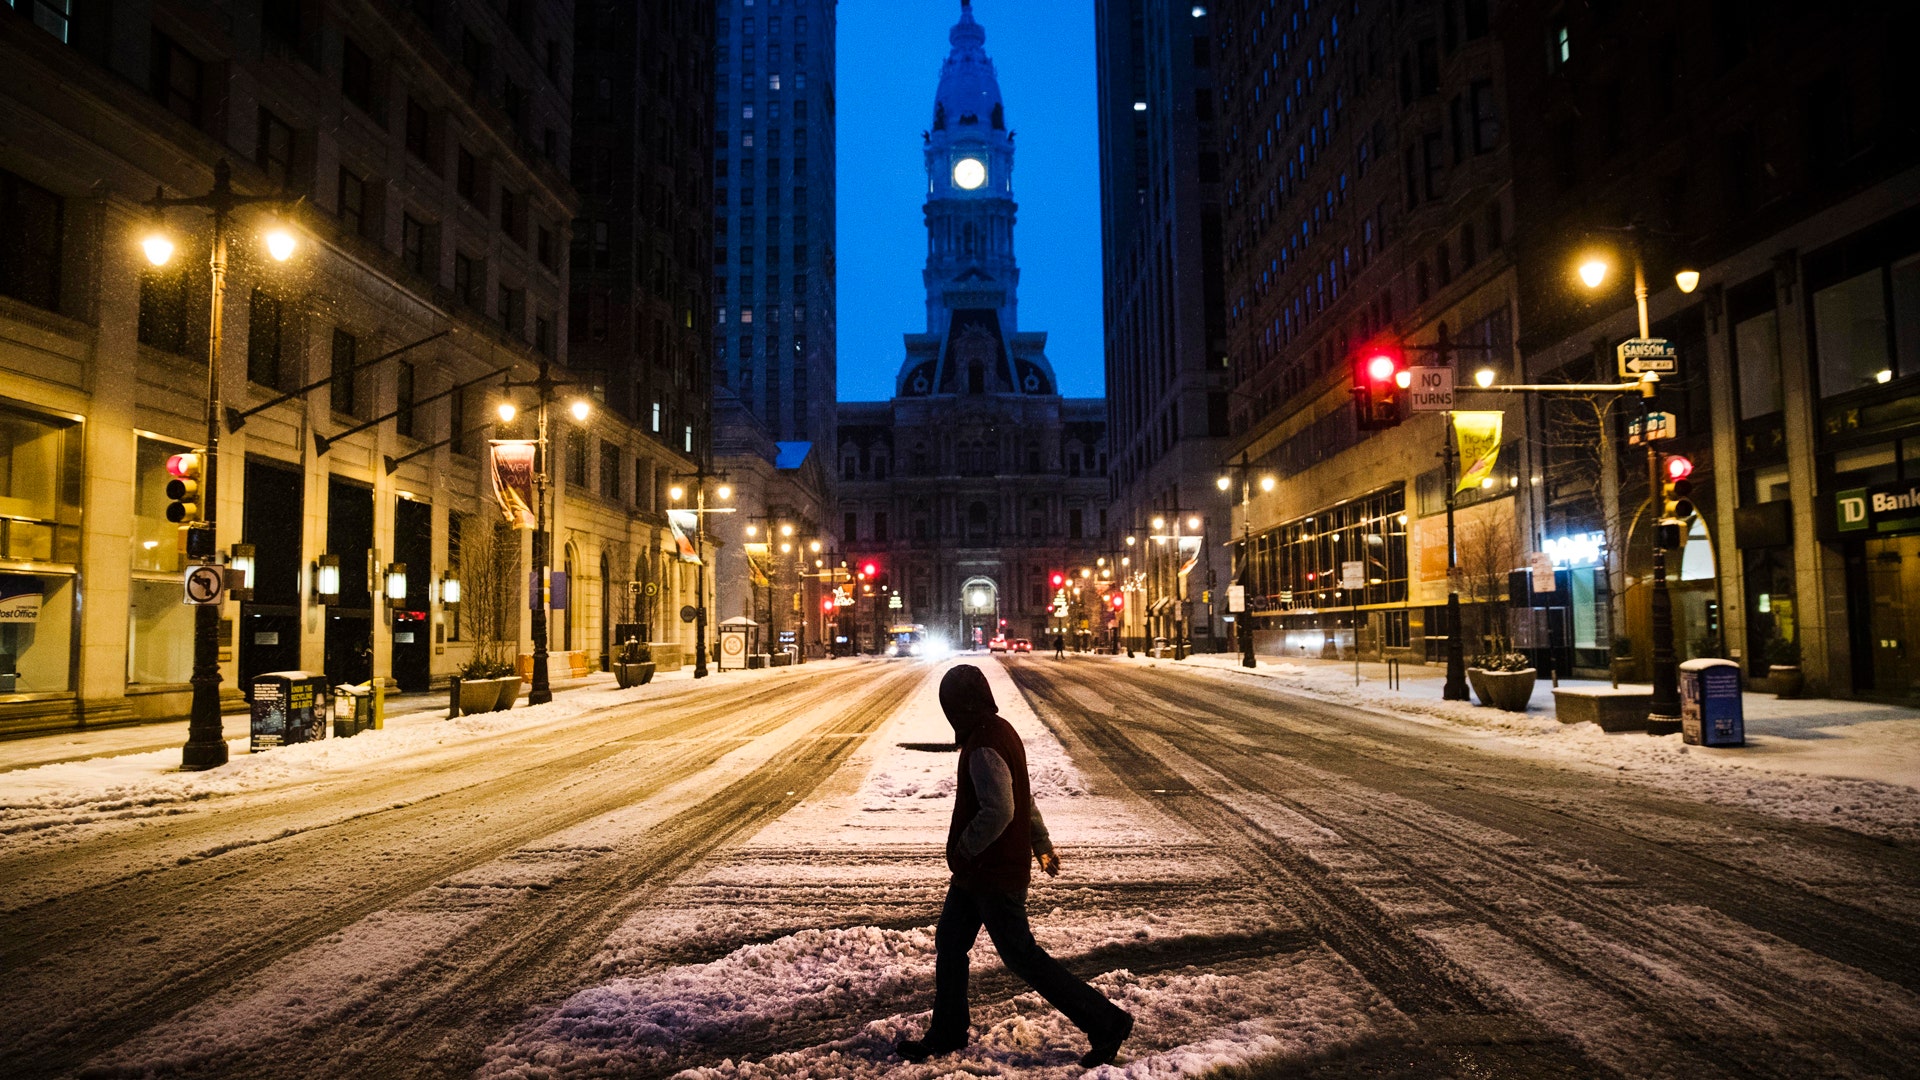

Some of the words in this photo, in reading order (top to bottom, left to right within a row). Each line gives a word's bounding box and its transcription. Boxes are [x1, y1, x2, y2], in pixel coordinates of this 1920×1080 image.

[1624, 344, 1664, 355] SANSOM
[1421, 373, 1442, 387] NO
[1413, 393, 1452, 405] TURNS
[1463, 435, 1494, 444] flowe
[1465, 446, 1489, 459] sho
[1840, 497, 1865, 523] TD
[14, 609, 37, 618] Office
[291, 692, 313, 701] RECYCLING
